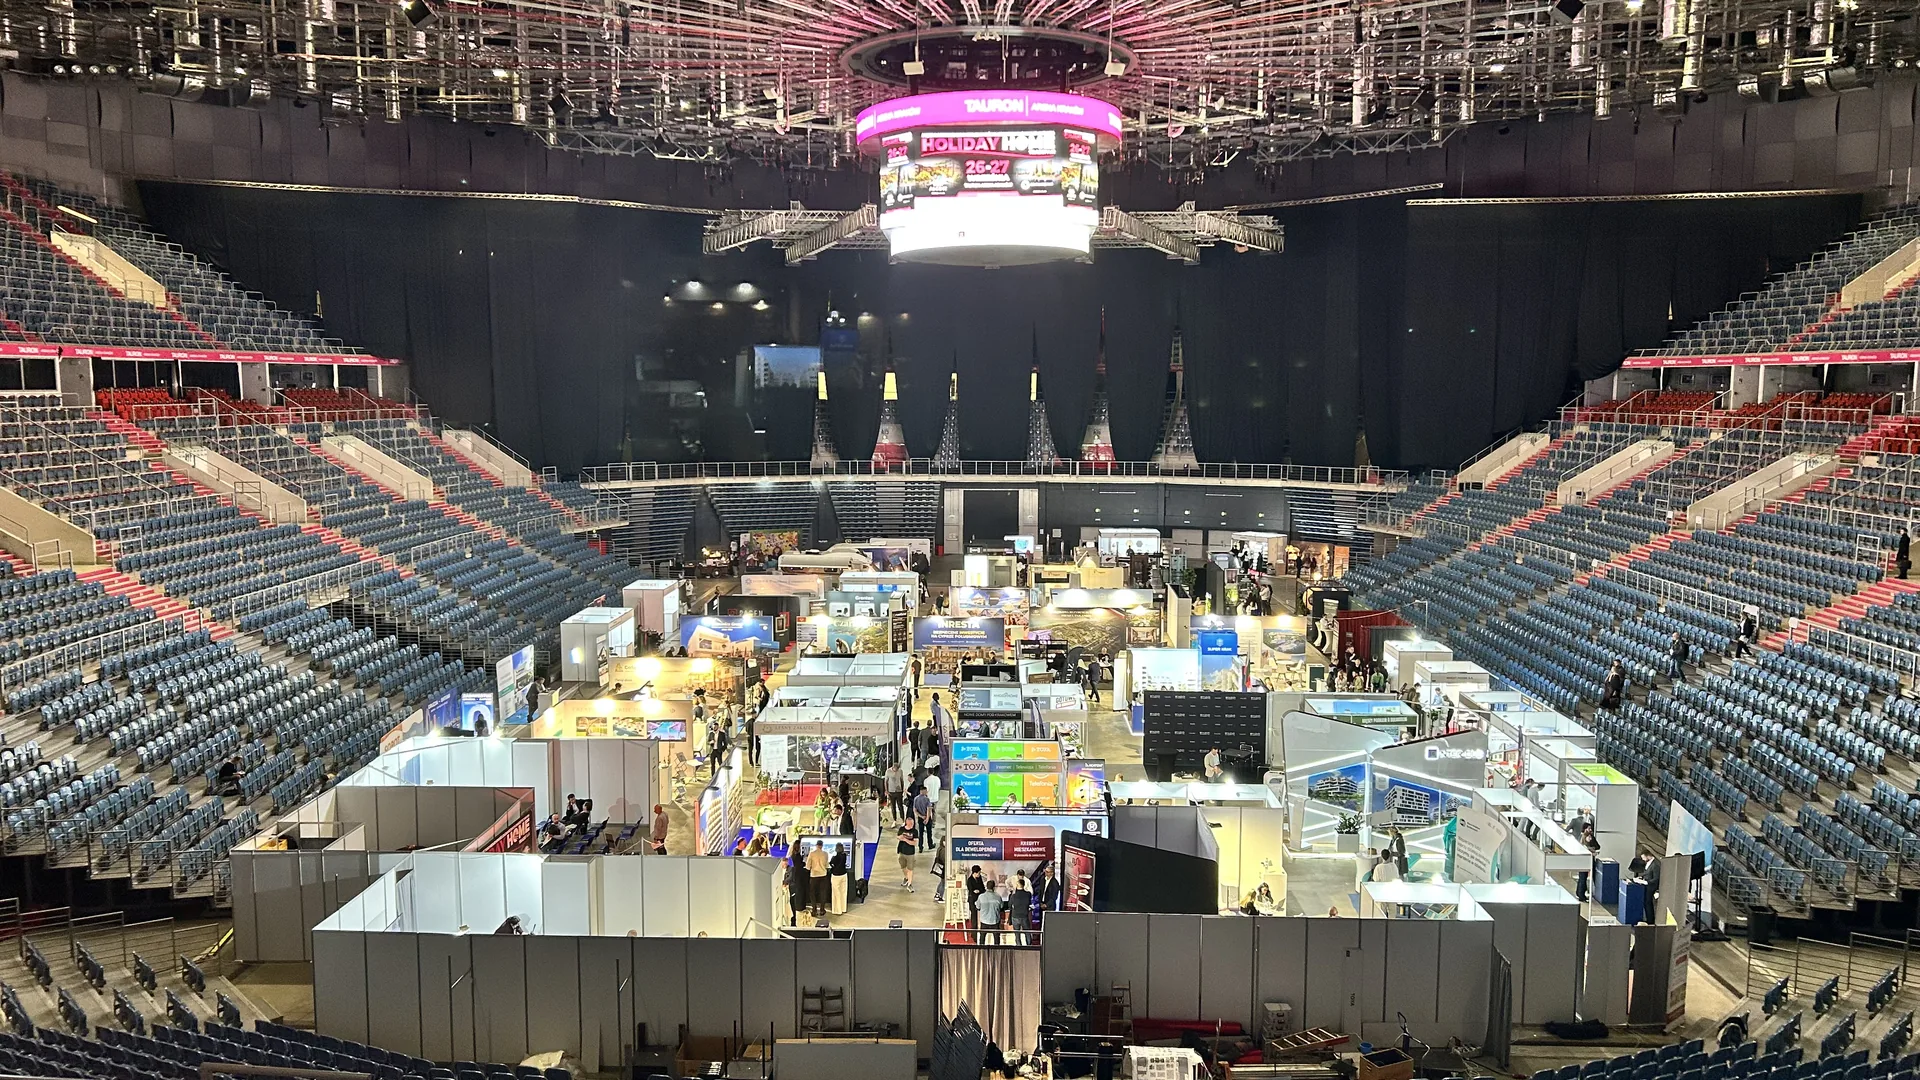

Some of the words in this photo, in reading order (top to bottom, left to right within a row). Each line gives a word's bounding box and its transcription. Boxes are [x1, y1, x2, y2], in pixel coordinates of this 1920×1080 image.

[963, 99, 1023, 112] TAURON
[921, 136, 1000, 152] HOLIDAY
[963, 763, 987, 771] TOYA
[506, 817, 530, 849] HOME
